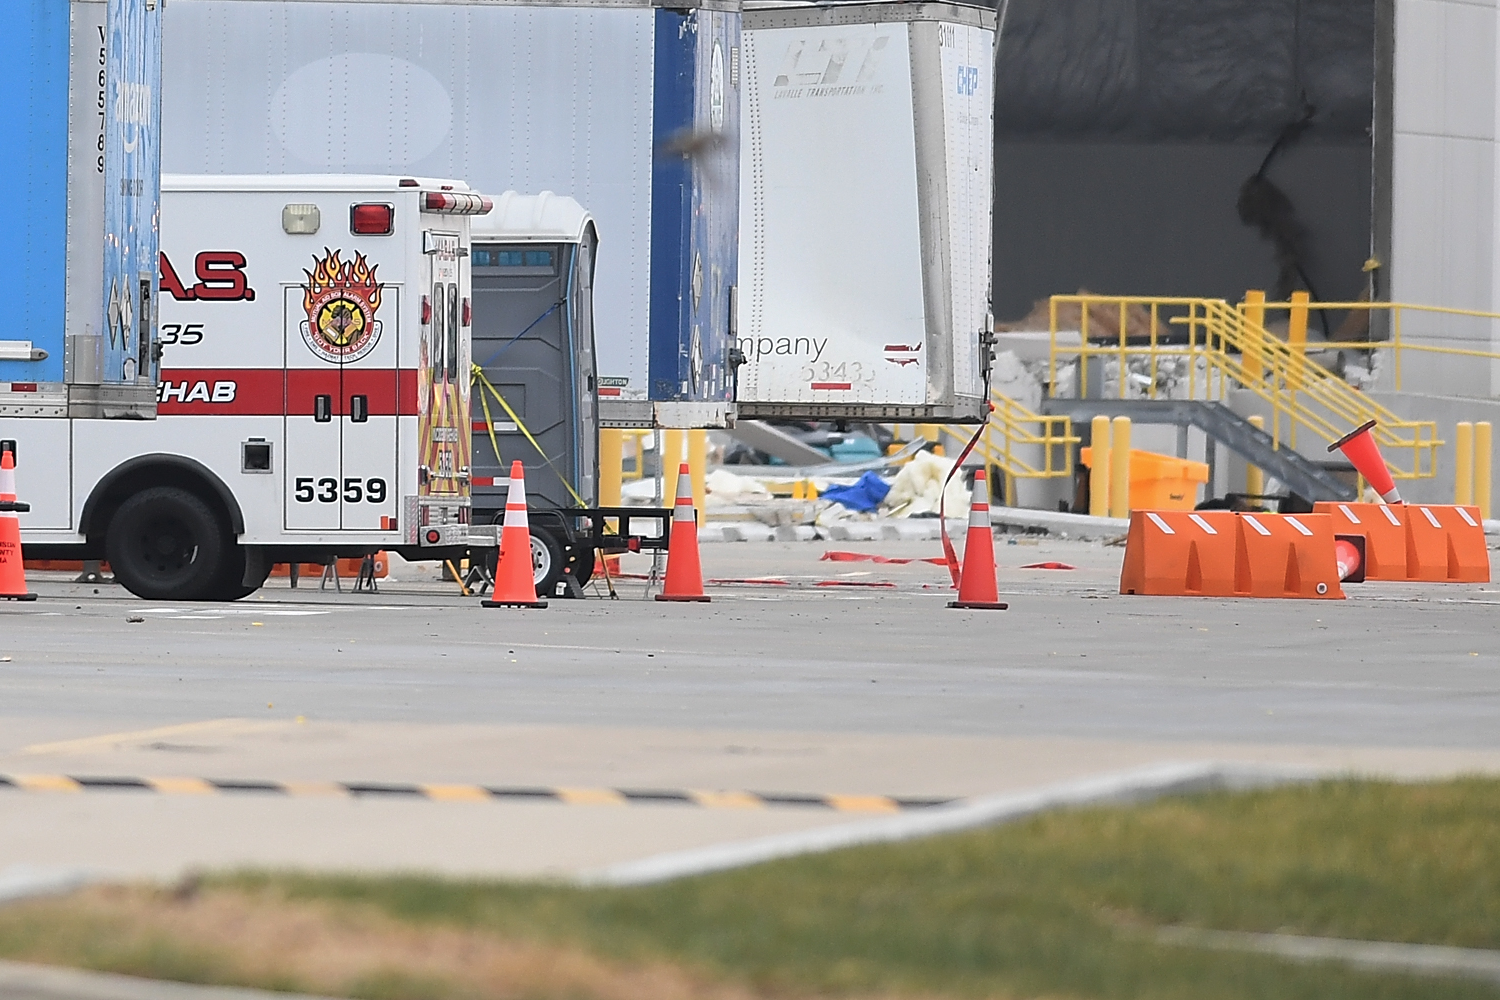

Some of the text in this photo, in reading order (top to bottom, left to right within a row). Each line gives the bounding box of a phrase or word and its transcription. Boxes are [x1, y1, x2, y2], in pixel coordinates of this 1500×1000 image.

[97, 25, 107, 174] V565789
[161, 324, 205, 345] 35
[295, 477, 387, 504] 5359
